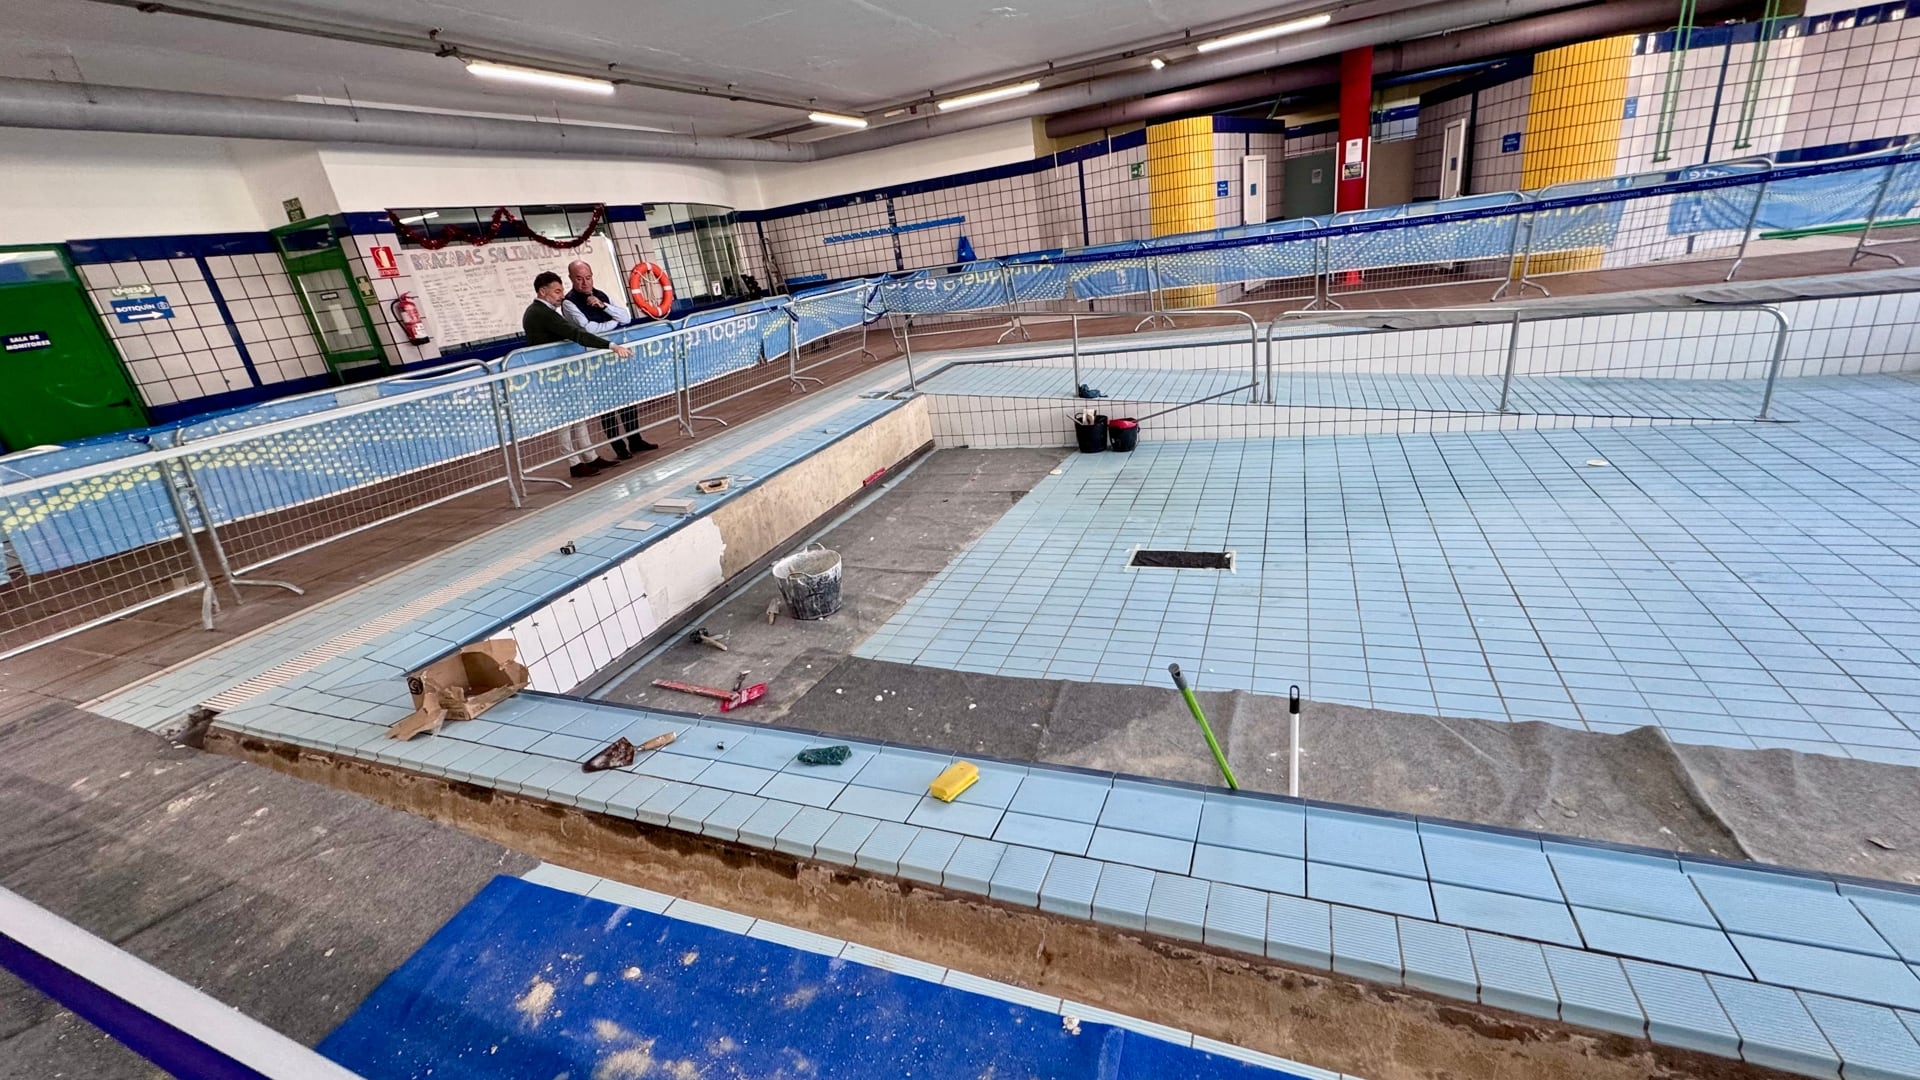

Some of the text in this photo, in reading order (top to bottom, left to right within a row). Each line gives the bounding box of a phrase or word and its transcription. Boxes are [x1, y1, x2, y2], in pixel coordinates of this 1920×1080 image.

[410, 248, 485, 271] BRAZADAS
[115, 303, 156, 313] BOTIQUÍN
[6, 340, 51, 350] MONITORES
